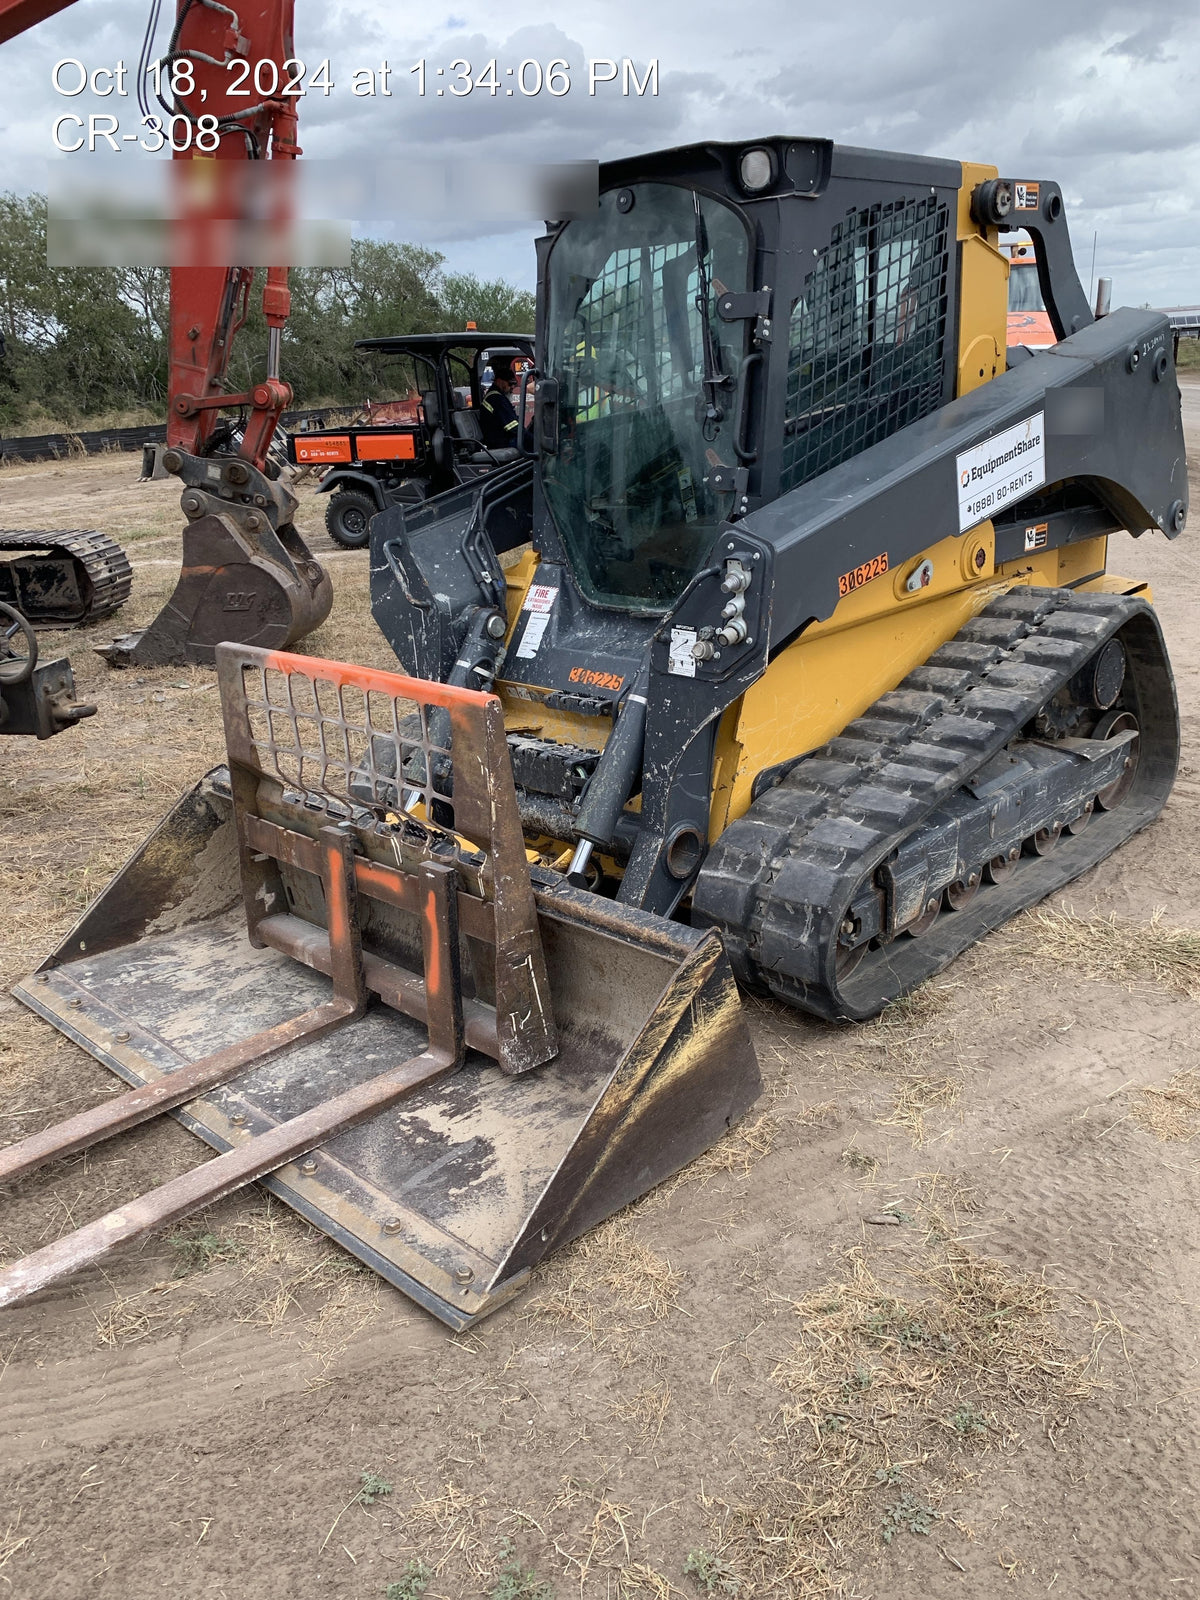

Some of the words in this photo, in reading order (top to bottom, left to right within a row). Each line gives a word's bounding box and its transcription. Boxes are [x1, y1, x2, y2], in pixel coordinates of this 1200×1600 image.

[971, 435, 1041, 481] EquipmentShare
[972, 492, 995, 515] (888)
[997, 471, 1033, 500] 80-RENTS
[534, 588, 550, 599] FIRE
[840, 553, 888, 595] 306225
[570, 667, 622, 690] 306225
